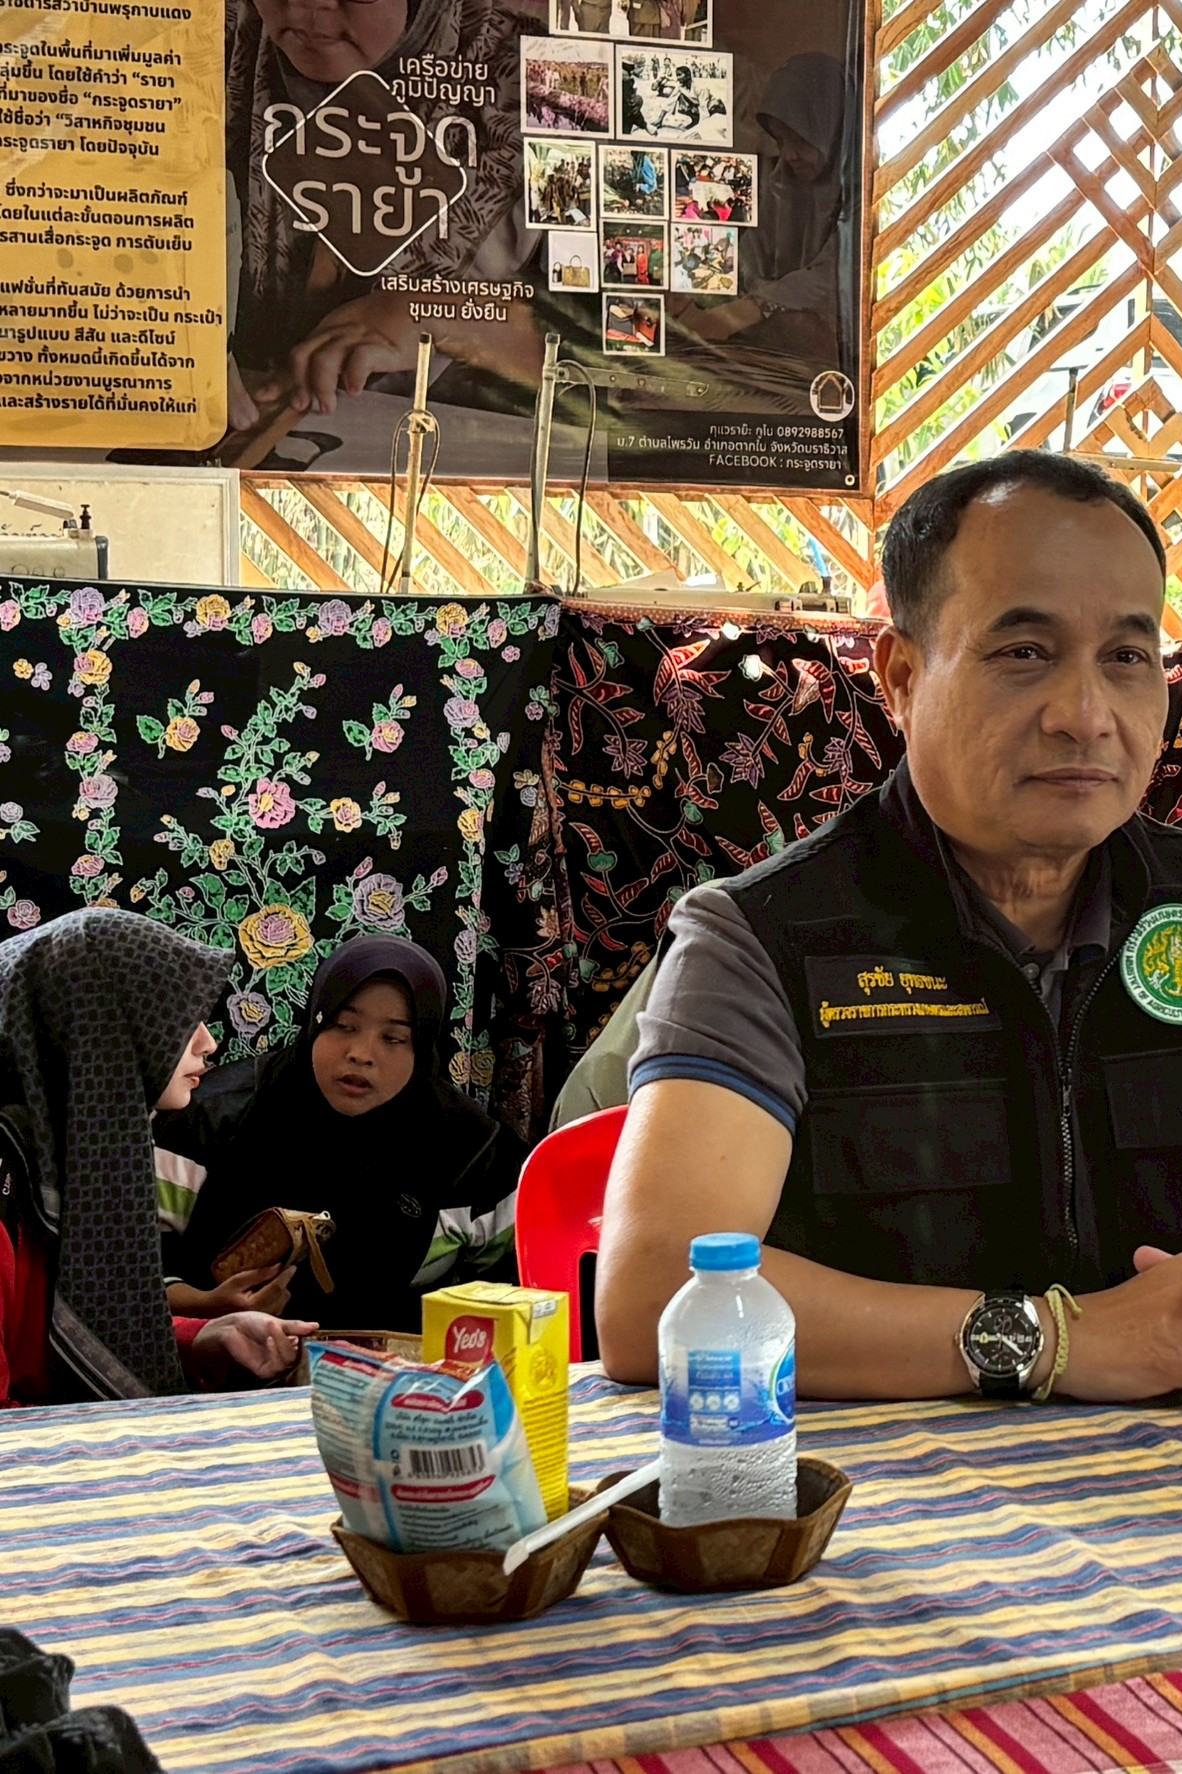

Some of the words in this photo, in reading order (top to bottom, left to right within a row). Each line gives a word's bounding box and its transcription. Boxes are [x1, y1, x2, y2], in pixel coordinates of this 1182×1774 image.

[48, 65, 127, 85] โดยใช้คำว่า
[399, 53, 489, 80] เครือข่าย
[391, 76, 496, 107] ภูมิปัญญา
[0, 135, 75, 152] ระจูดรายา
[80, 137, 159, 159] โดยปัจจุบัน
[263, 103, 477, 186] กระจูด
[292, 180, 449, 240] รายา
[116, 281, 190, 301] ด้วยการนำ
[381, 274, 535, 300] เสริมสร้างเศรษฐกิจ
[93, 304, 168, 323] ไม่ว่าจะเป็น
[174, 309, 222, 326] กระเป๋า
[410, 301, 455, 322] ชุมชน
[461, 299, 507, 321] ยั่งยืน
[74, 326, 105, 342] สีสัน
[111, 329, 175, 345] และดีไซน์
[38, 345, 195, 369] ทั้งหมดนี้เกิดขึ้นได้จาก
[776, 427, 844, 440] 0892988567
[709, 454, 776, 468] FACEBOOK
[786, 458, 841, 472] กระจูดรายา
[453, 1325, 487, 1354] Yeo's
